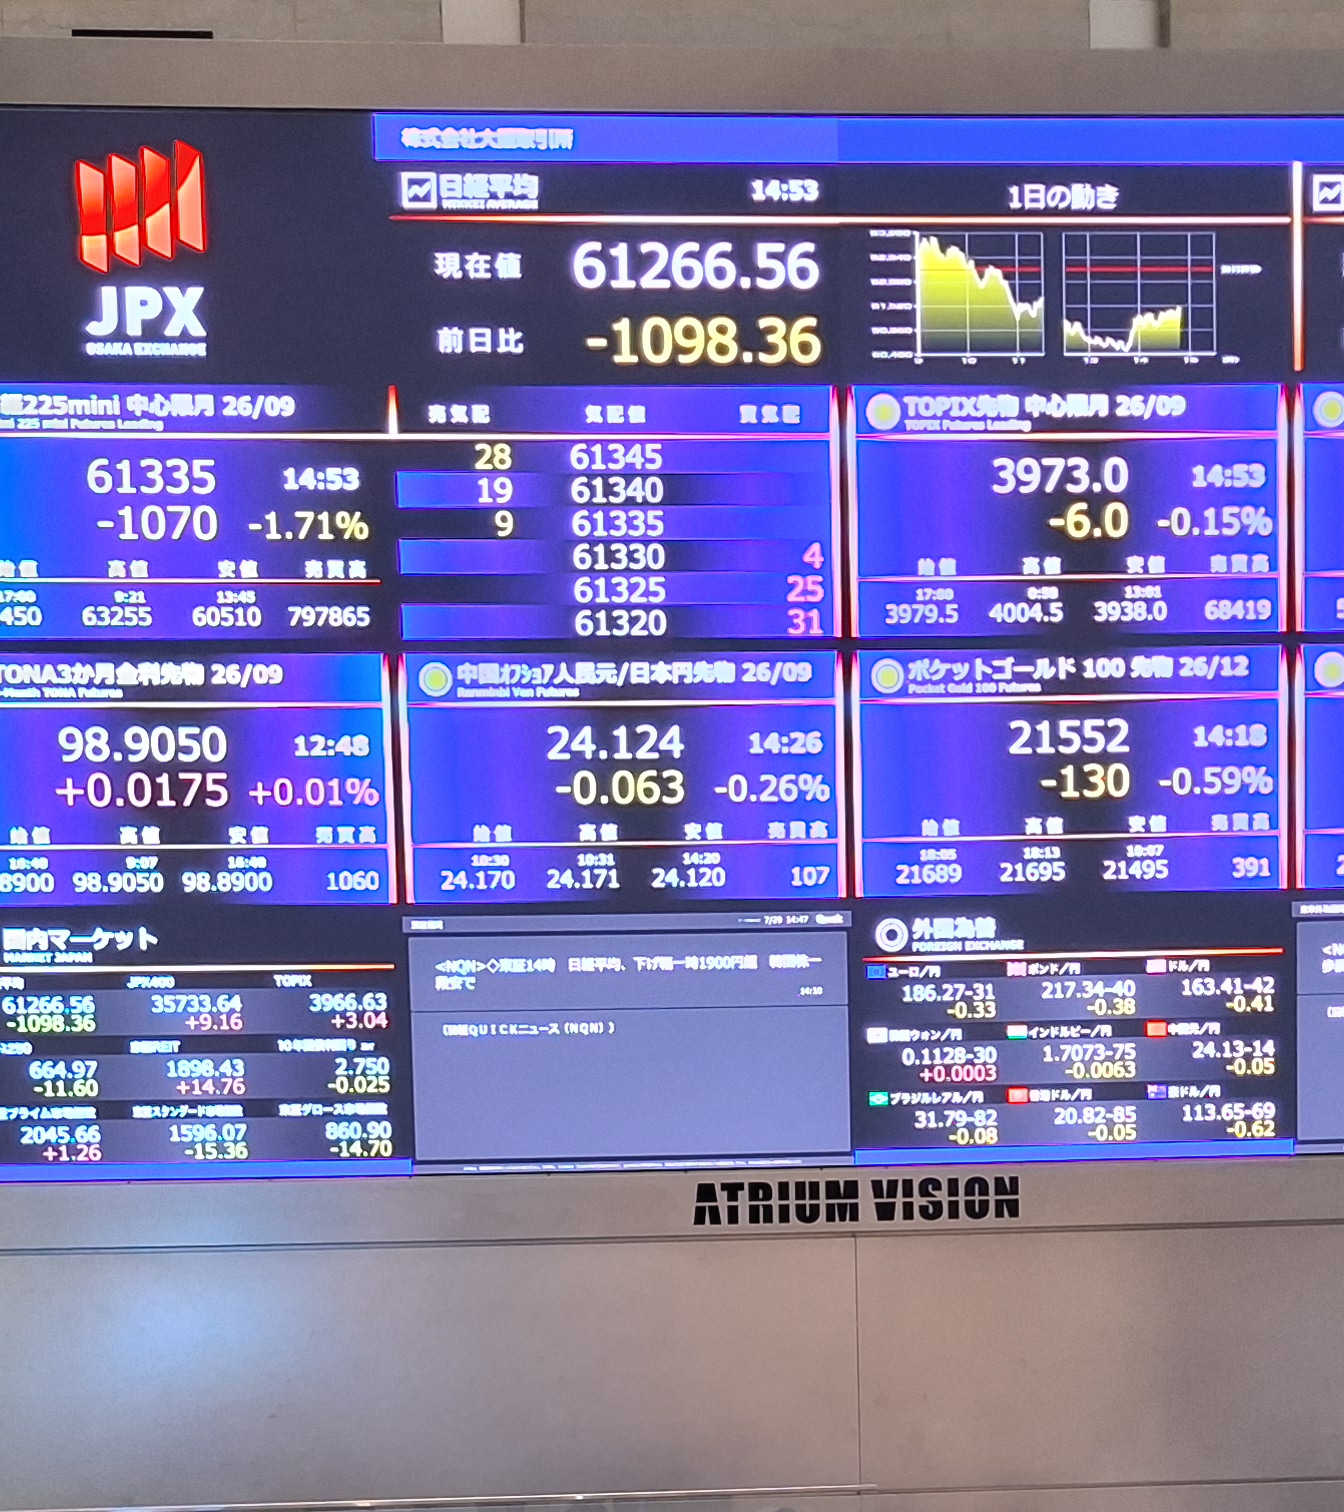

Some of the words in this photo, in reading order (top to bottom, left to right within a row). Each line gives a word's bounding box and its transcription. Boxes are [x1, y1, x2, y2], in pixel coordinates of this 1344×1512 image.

[751, 179, 819, 201] 14:53
[1009, 184, 1119, 210] 1日の動き
[434, 252, 522, 279] 現在値
[573, 242, 819, 289] 61266.56
[85, 286, 206, 336] JPX
[437, 327, 523, 353] 前日比
[586, 317, 821, 363] -1098.36
[222, 395, 295, 419] 26/09
[1115, 395, 1186, 419] 26/09
[475, 443, 512, 469] 28
[570, 443, 662, 470] 61345
[87, 458, 215, 494] 61335
[283, 467, 359, 490] 14:53
[992, 457, 1128, 493] 3973.0
[1192, 464, 1265, 487] 14:53
[478, 477, 513, 503] 19
[571, 477, 663, 503] 61340
[97, 505, 217, 540] -1070
[249, 511, 369, 539] -1.71%
[495, 510, 513, 536] 9
[572, 510, 663, 536] 61335
[1049, 502, 1128, 538] -6.0
[1157, 506, 1273, 536] -0.15%
[573, 543, 665, 570] 61330
[803, 542, 824, 568] 4
[574, 577, 665, 603] 61325
[787, 575, 824, 602] 25
[82, 606, 152, 626] 63255
[192, 606, 261, 626] 60510
[288, 606, 370, 626] 797865
[575, 609, 666, 636] 61320
[788, 609, 826, 636] 31
[886, 604, 958, 623] 3979.5
[989, 602, 1063, 623] 4004.5
[1094, 601, 1167, 621] 3938.0
[1205, 599, 1271, 620] 68419
[211, 664, 283, 687] 26/09
[742, 662, 812, 685] 26/09
[908, 657, 1076, 685] ポケットゴールド
[1083, 658, 1125, 678] 100
[1179, 655, 1249, 679] 26/12
[58, 726, 226, 762] 98.9050
[295, 734, 369, 756] 12:48
[547, 724, 684, 760] 24.124
[749, 731, 823, 753] 14:26
[1009, 718, 1129, 754] 21552
[56, 772, 228, 807] +0.0175
[249, 778, 379, 805] +0.01%
[556, 769, 684, 805] -0.063
[715, 774, 830, 802] -0.26%
[1041, 763, 1129, 797] -130
[1159, 766, 1273, 795] -0.59%
[73, 872, 164, 892] 98.9050
[182, 872, 272, 892] 98.8900
[327, 871, 379, 890] 1060
[441, 870, 515, 890] 24.170
[547, 869, 620, 888] 24.171
[652, 867, 725, 887] 24.120
[792, 866, 830, 886] 107
[896, 864, 962, 884] 21689
[1000, 862, 1065, 882] 21695
[1103, 859, 1168, 879] 21495
[1233, 857, 1270, 878] 391
[903, 983, 995, 1003] 186.27-31
[1042, 980, 1136, 1000] 217.34-40
[1182, 977, 1275, 997] 163.41-42
[2, 996, 95, 1016] 61266.56
[151, 995, 242, 1015] 35733.64
[309, 993, 387, 1013] 3966.63
[947, 1001, 996, 1018] -0.33
[1087, 998, 1135, 1015] -0.38
[1226, 995, 1274, 1012] -0.41
[7, 1014, 96, 1032] -1098.36
[185, 1013, 242, 1030] +9.16
[331, 1012, 388, 1028] +3.04
[902, 1046, 997, 1066] 0.1128-30
[1044, 1043, 1136, 1064] 1.7073-75
[1192, 1040, 1275, 1061] 24.13-14
[29, 1061, 97, 1081] 664.97
[167, 1059, 244, 1079] 1898.43
[335, 1058, 389, 1078] 2.750
[920, 1064, 996, 1082] +0.0003
[1065, 1061, 1135, 1079] -0.0063
[1226, 1058, 1274, 1075] -0.05
[34, 1079, 98, 1097] -11.60
[176, 1078, 245, 1095] +14.76
[328, 1076, 390, 1093] -0.025
[915, 1109, 998, 1130] 31.79-82
[1054, 1106, 1136, 1126] 20.82-85
[1183, 1102, 1275, 1122] 113.65-69
[21, 1125, 101, 1145] 2045.66
[169, 1123, 246, 1144] 1596.07
[326, 1122, 392, 1141] 860.90
[949, 1127, 998, 1144] -0.08
[1088, 1124, 1136, 1141] -0.05
[1227, 1120, 1275, 1138] -0.62
[42, 1143, 101, 1161] +1.26
[185, 1142, 248, 1159] -15.36
[330, 1140, 392, 1157] -14.70
[693, 1179, 859, 1225] ATRIUM
[870, 1175, 1020, 1222] VISION
